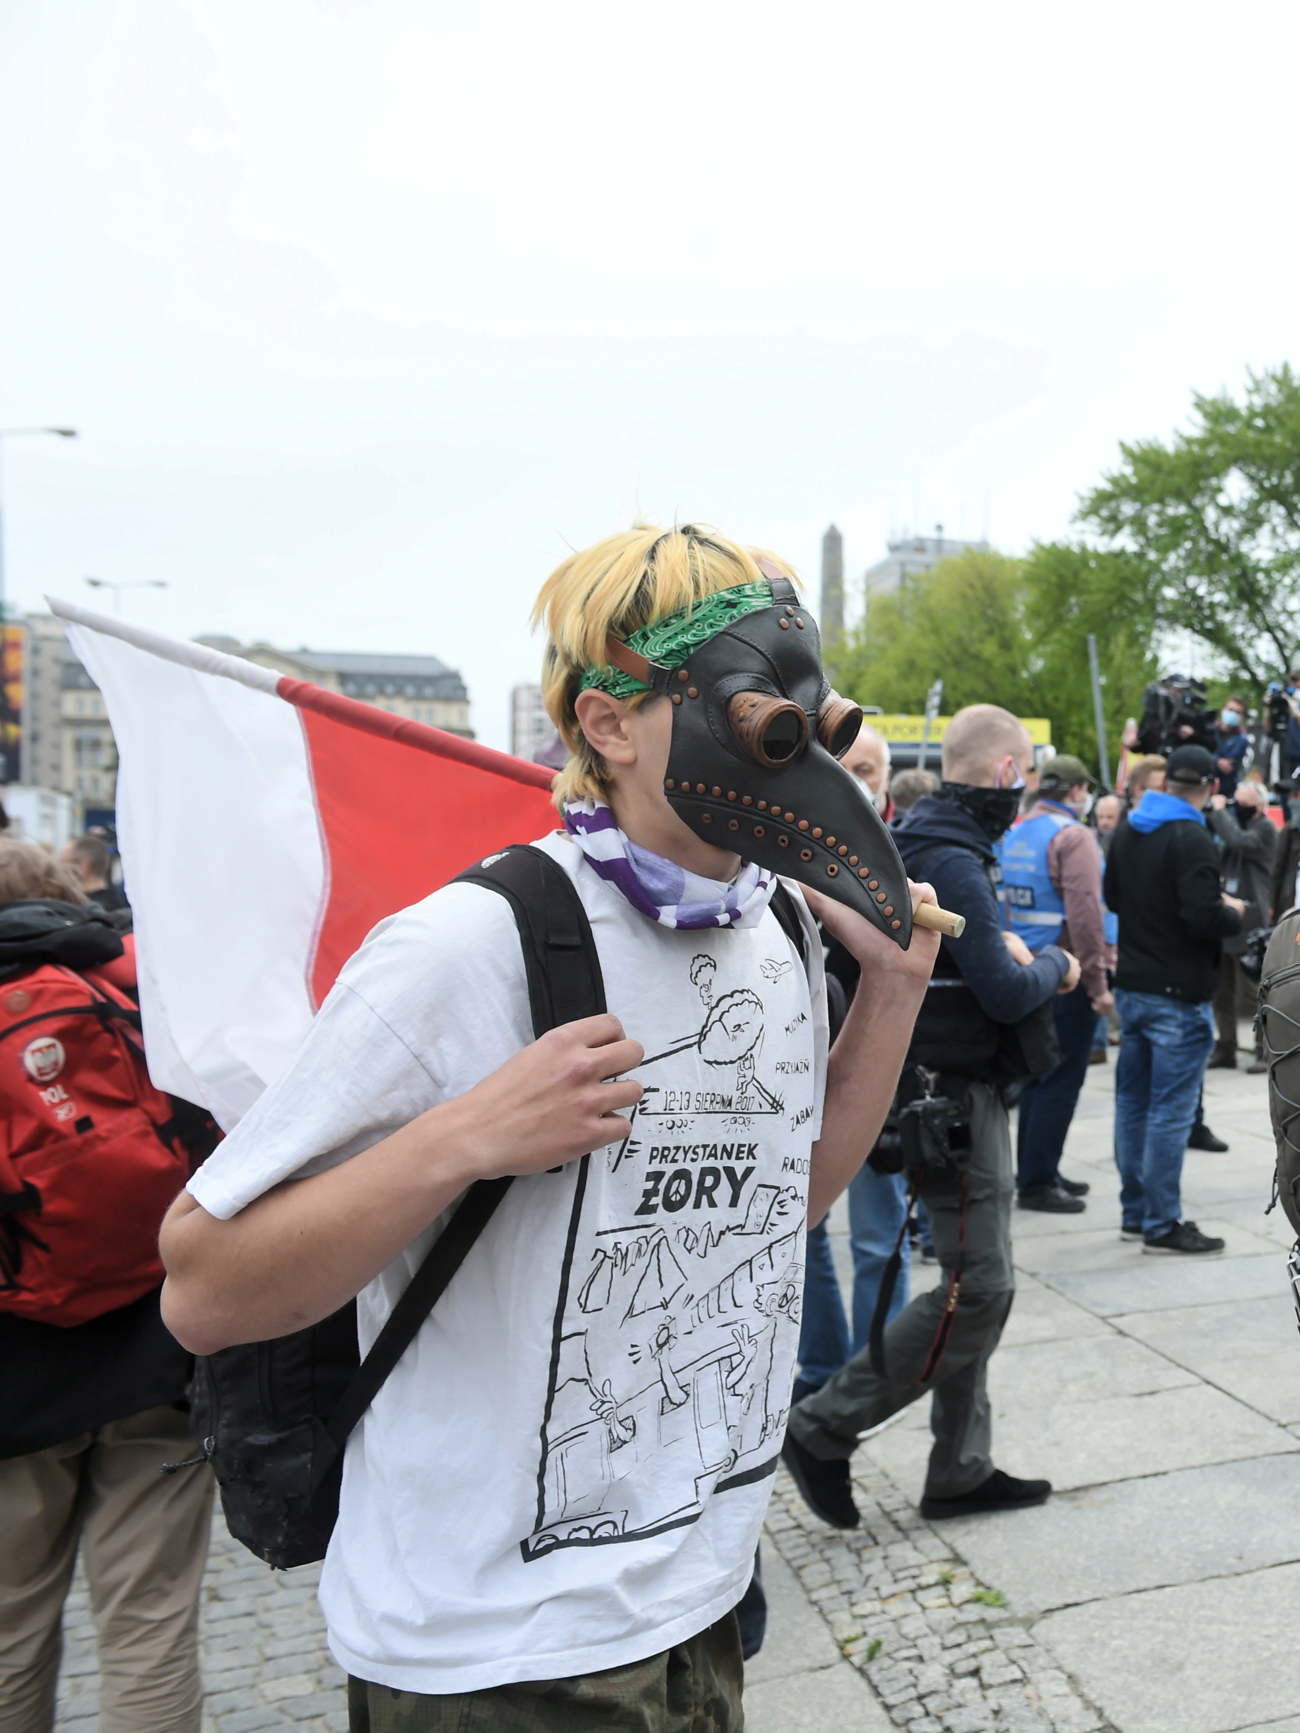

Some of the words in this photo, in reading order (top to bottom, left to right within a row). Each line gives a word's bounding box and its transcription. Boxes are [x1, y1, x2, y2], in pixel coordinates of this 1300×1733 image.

[38, 1084, 69, 1107] POL
[663, 1091, 691, 1111] 12-13
[734, 1096, 756, 1111] 2017
[648, 1143, 759, 1165] PRZYSTANEK
